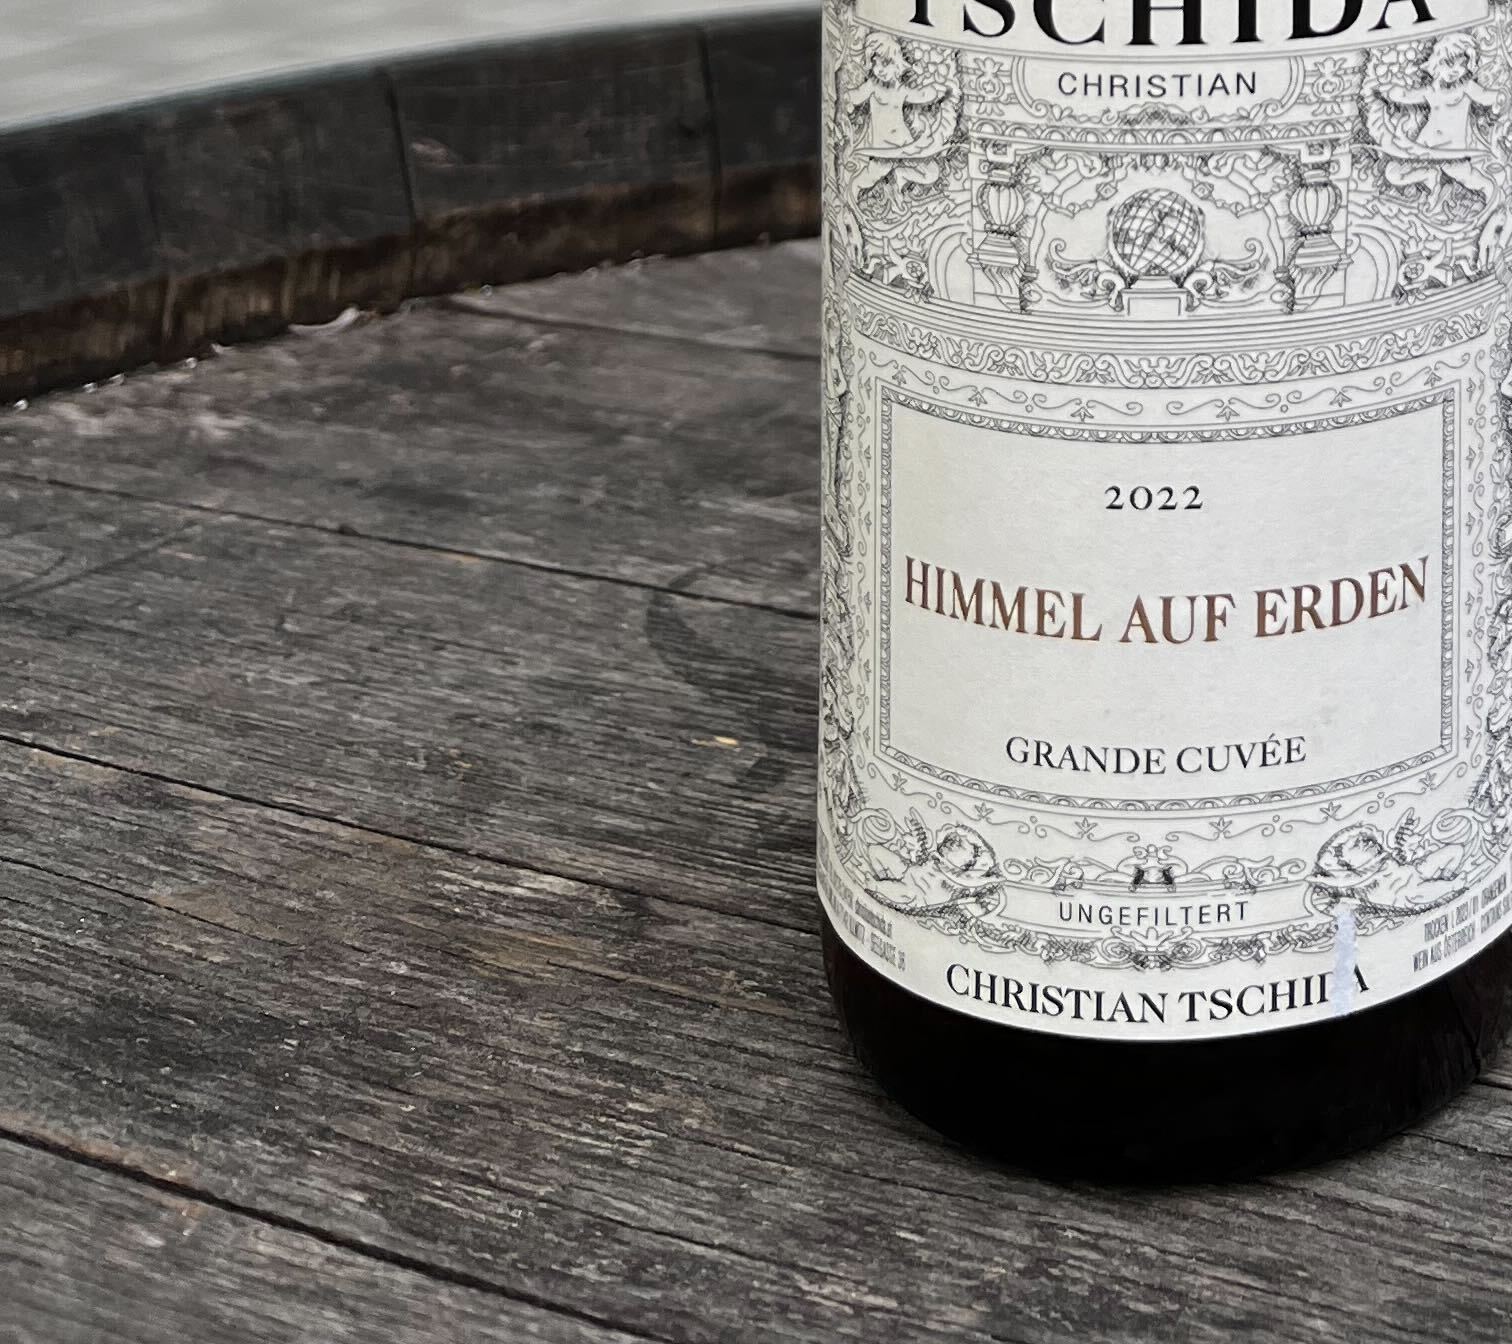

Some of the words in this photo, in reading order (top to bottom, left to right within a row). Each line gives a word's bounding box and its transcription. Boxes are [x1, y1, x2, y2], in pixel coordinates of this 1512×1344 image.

[1057, 70, 1257, 98] CHRISTIAN
[1104, 484, 1204, 511] 2022
[904, 554, 1103, 643] HIMMEL
[1119, 593, 1237, 645] AUF
[1253, 555, 1430, 639] ERDEN
[1005, 735, 1167, 776] GRANDE
[1175, 732, 1308, 774] CUVÉE
[1058, 900, 1250, 926] UNGEFILTERT
[945, 962, 1170, 1024] CHRISTIAN
